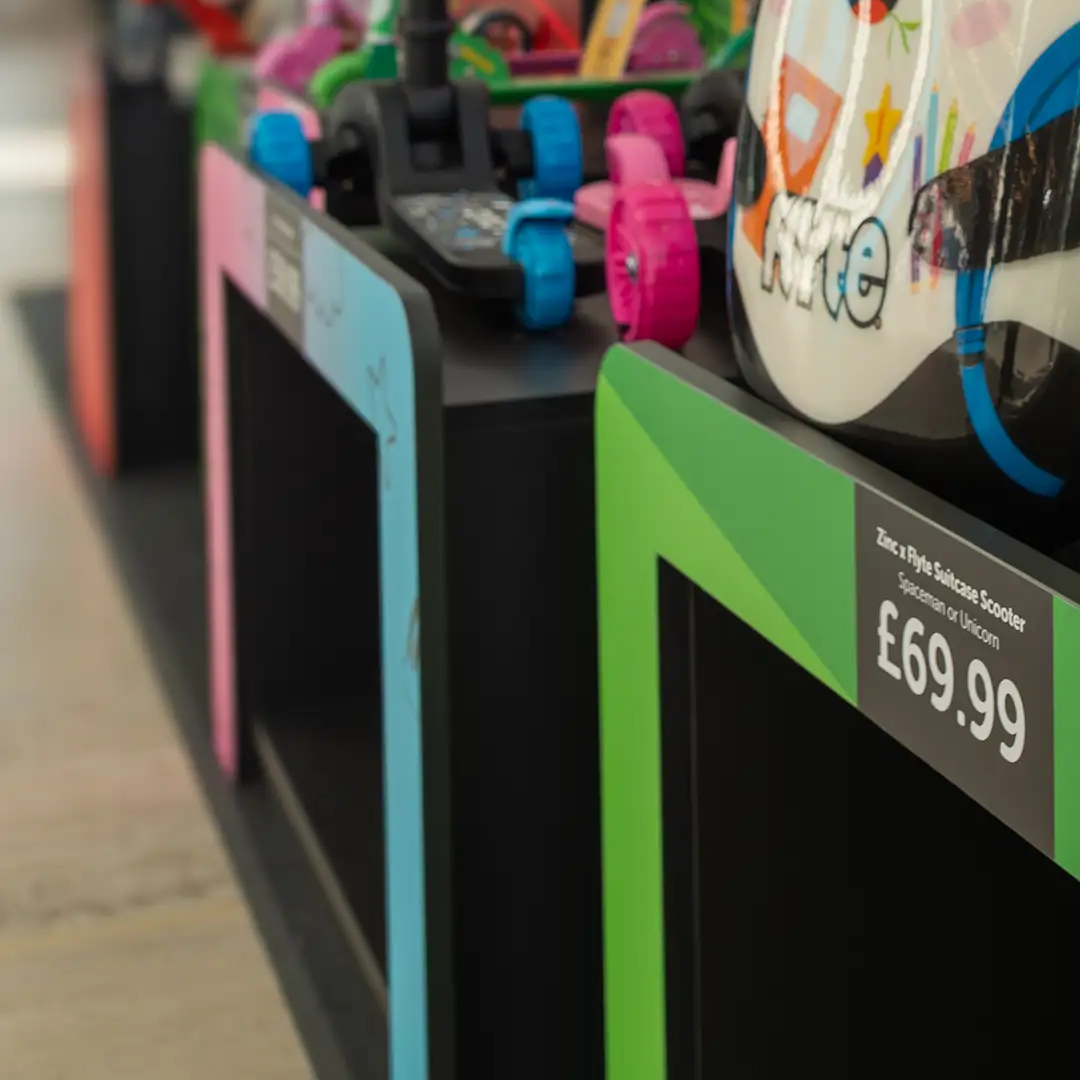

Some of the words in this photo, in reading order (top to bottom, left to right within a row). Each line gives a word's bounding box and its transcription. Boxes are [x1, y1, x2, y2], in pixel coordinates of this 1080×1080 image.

[876, 526, 899, 555] Zinc
[899, 544, 907, 560] x
[907, 544, 933, 576] Flyte
[933, 561, 979, 604] Suitcase
[980, 589, 1026, 633] Scooter
[897, 571, 946, 616] Spaceman
[946, 606, 958, 623] or
[959, 609, 1000, 651] Unicorn
[877, 599, 1026, 763] £69.99
